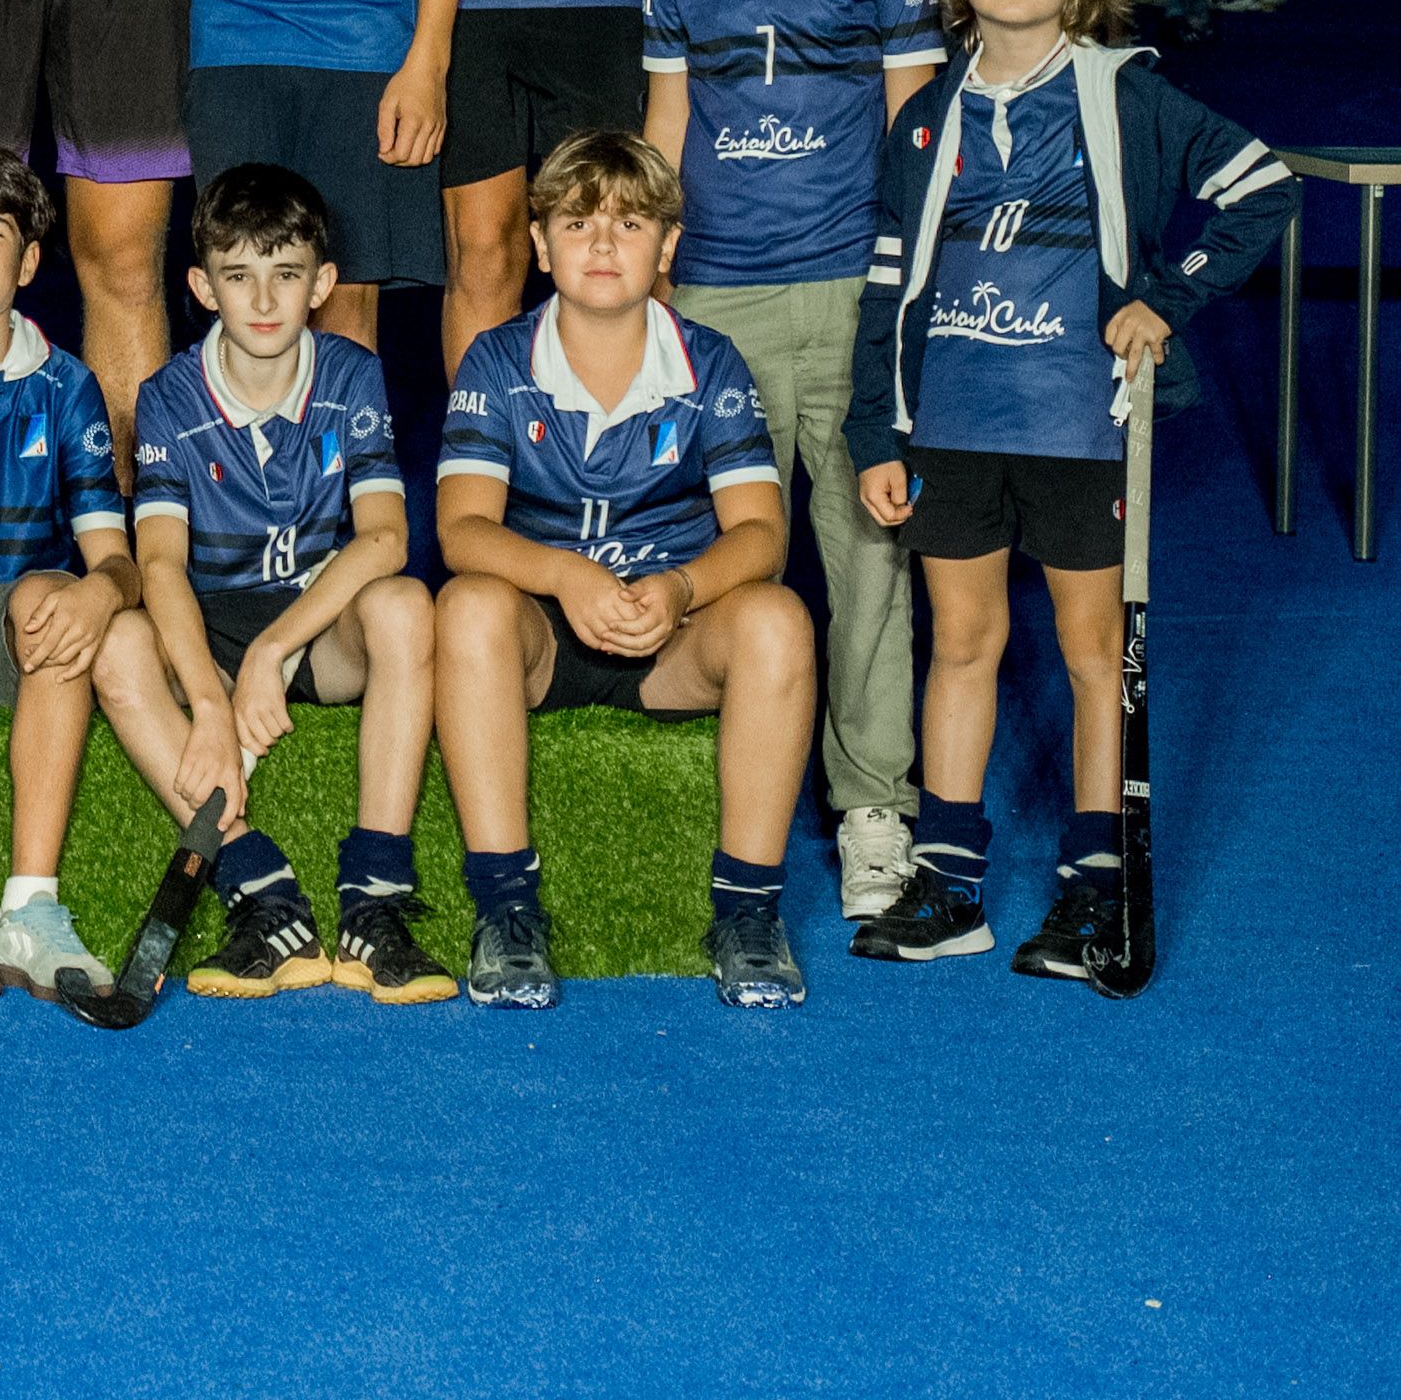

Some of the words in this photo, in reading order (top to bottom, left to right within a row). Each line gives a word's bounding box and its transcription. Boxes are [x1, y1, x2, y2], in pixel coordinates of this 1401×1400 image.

[714, 126, 774, 151] Enjoy
[774, 126, 827, 151] Cuba
[991, 301, 1066, 336] Cuba
[581, 497, 609, 540] 11
